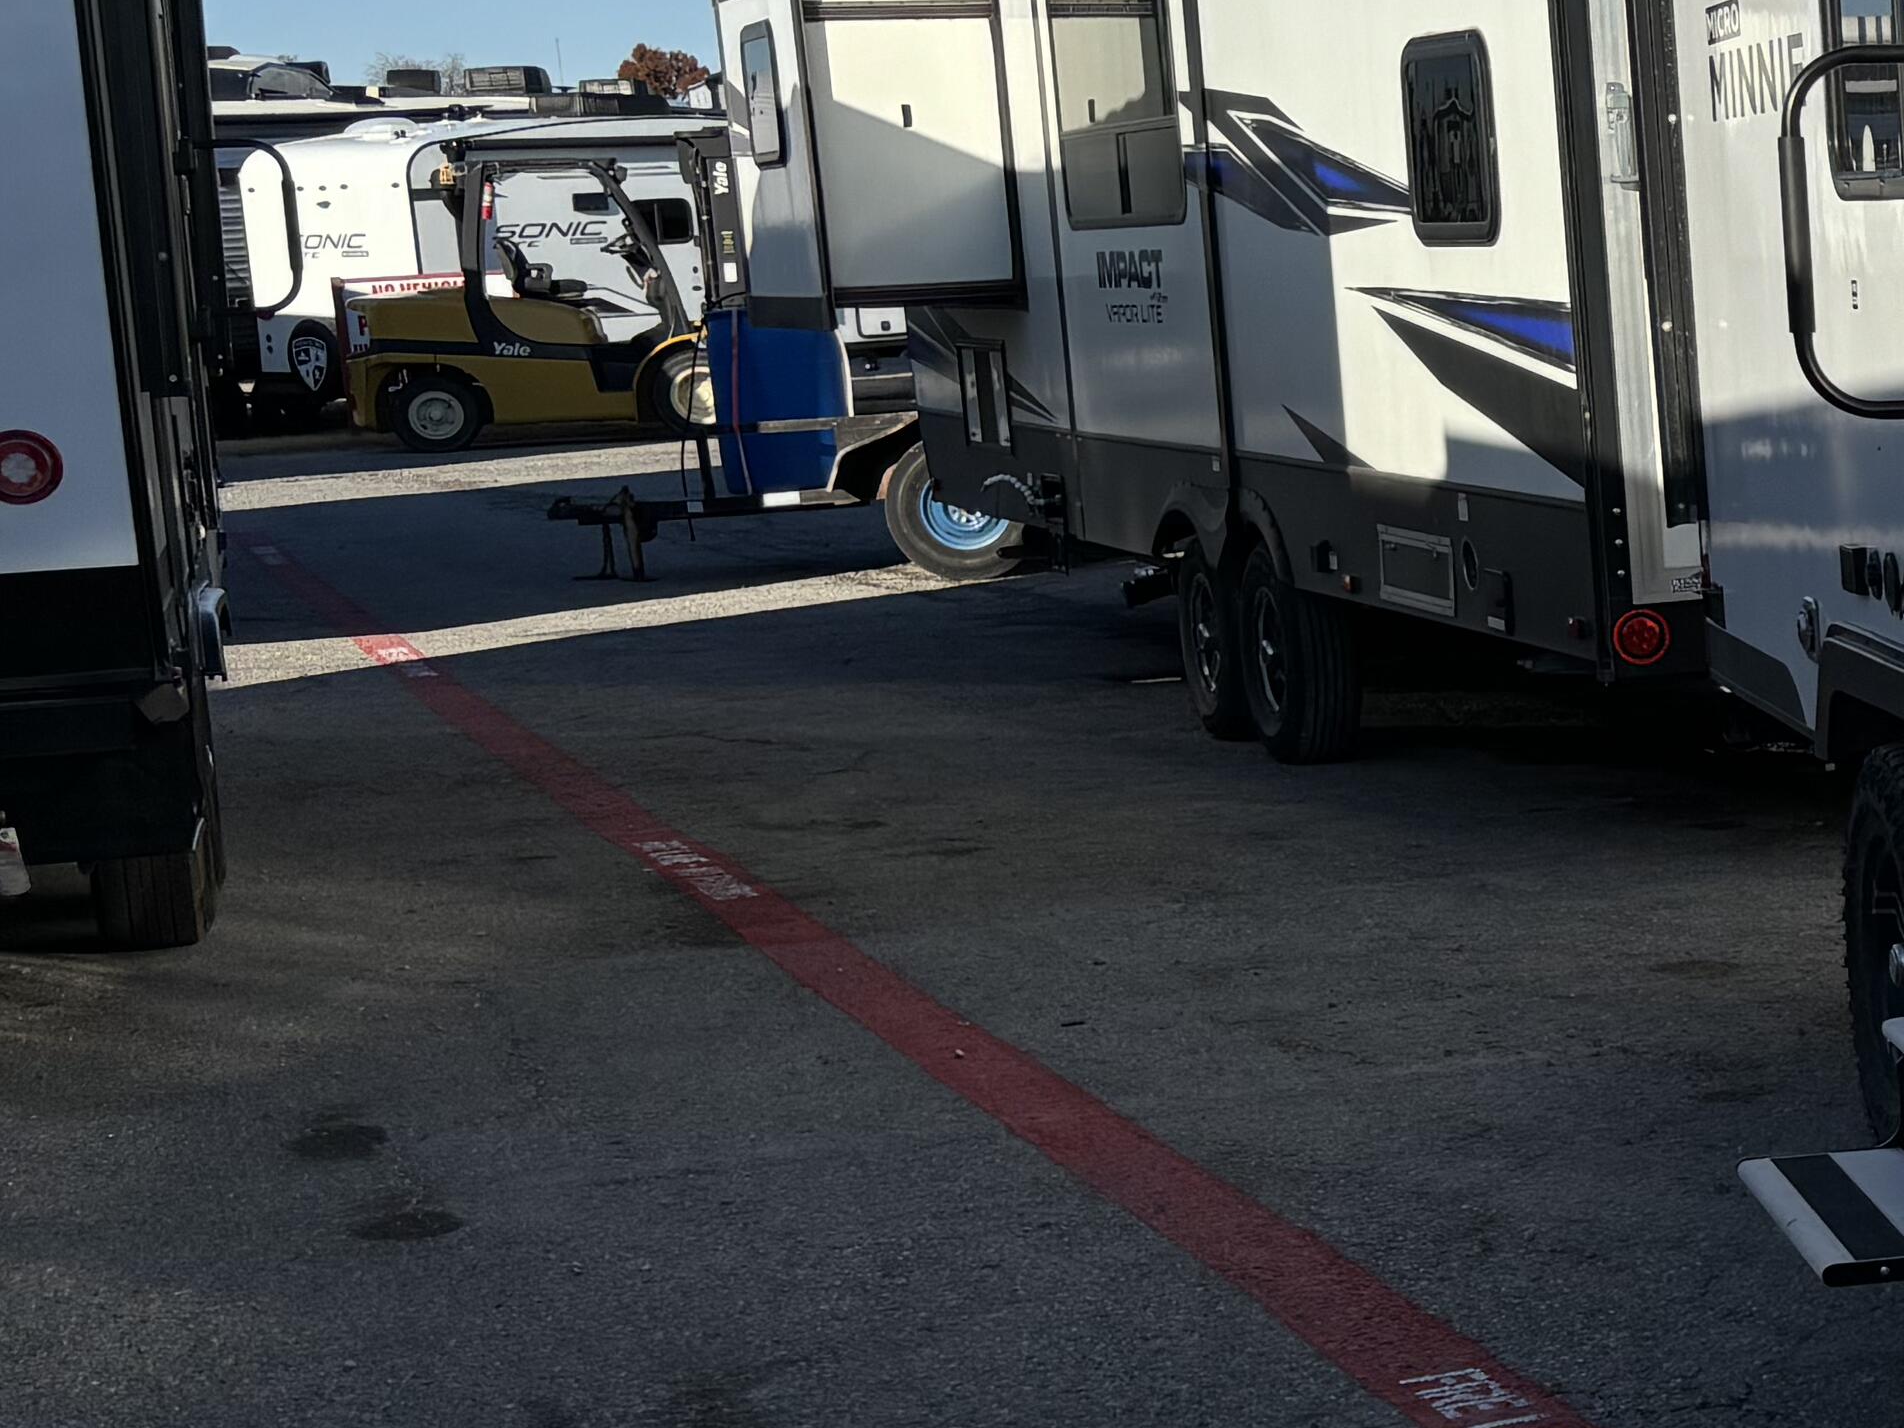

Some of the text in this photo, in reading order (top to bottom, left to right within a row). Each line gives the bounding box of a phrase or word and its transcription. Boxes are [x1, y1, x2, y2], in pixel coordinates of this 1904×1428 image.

[1705, 3, 1739, 41] MICRO
[493, 221, 607, 240] SONIC
[300, 233, 366, 249] ONIC
[1096, 249, 1163, 289] IMPACT
[1141, 304, 1163, 323] LITE
[494, 341, 531, 356] Yale
